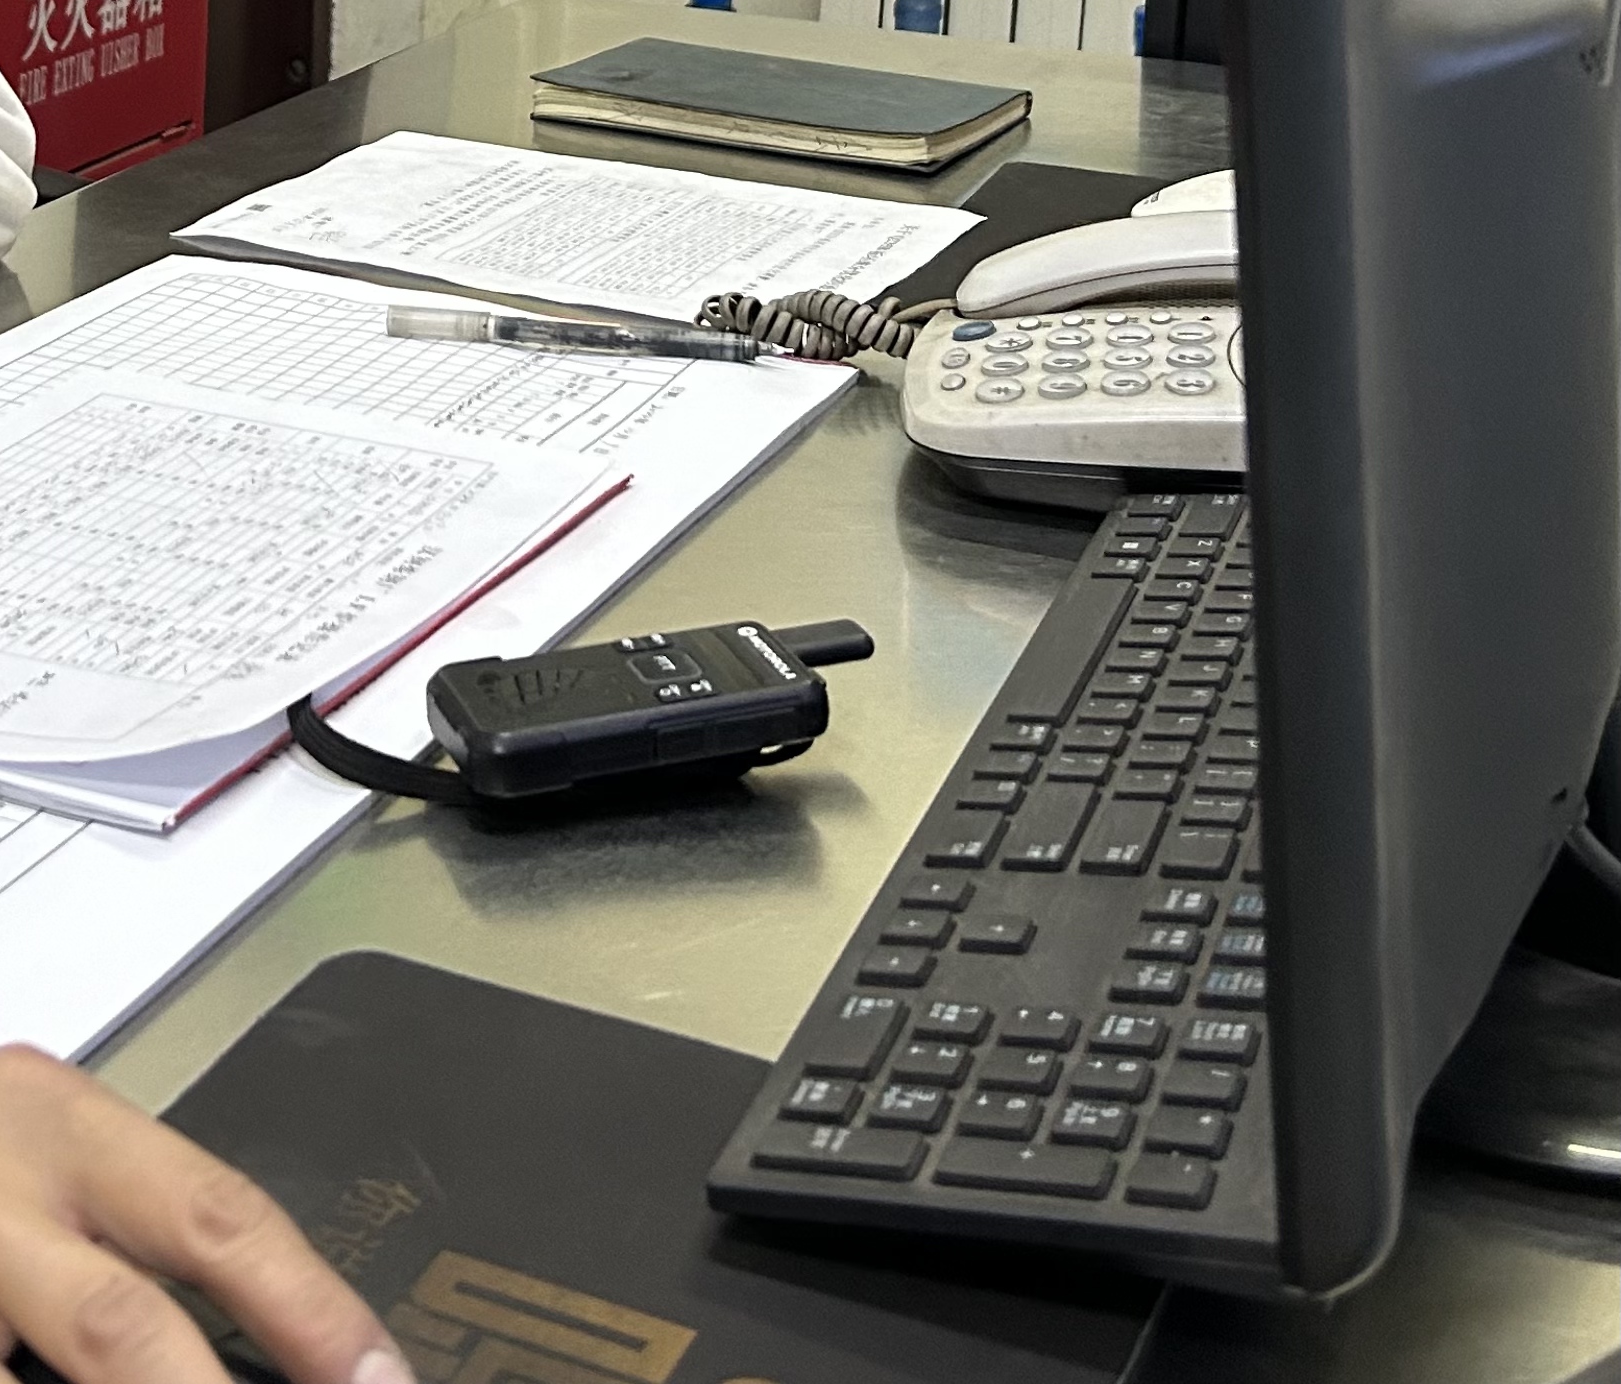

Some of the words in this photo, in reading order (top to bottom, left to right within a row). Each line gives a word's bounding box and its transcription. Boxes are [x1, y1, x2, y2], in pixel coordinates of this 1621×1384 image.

[1177, 353, 1206, 361] 2
[1177, 379, 1206, 388] 3
[876, 998, 894, 1008] 0
[963, 1006, 979, 1014] 1
[1047, 1010, 1064, 1020] 4
[1136, 1017, 1156, 1026] 7
[938, 1047, 958, 1058] 2
[1026, 1054, 1047, 1064] 5
[1116, 1061, 1137, 1072] 8
[1006, 1098, 1026, 1109] 6
[1100, 1107, 1121, 1118] 9
